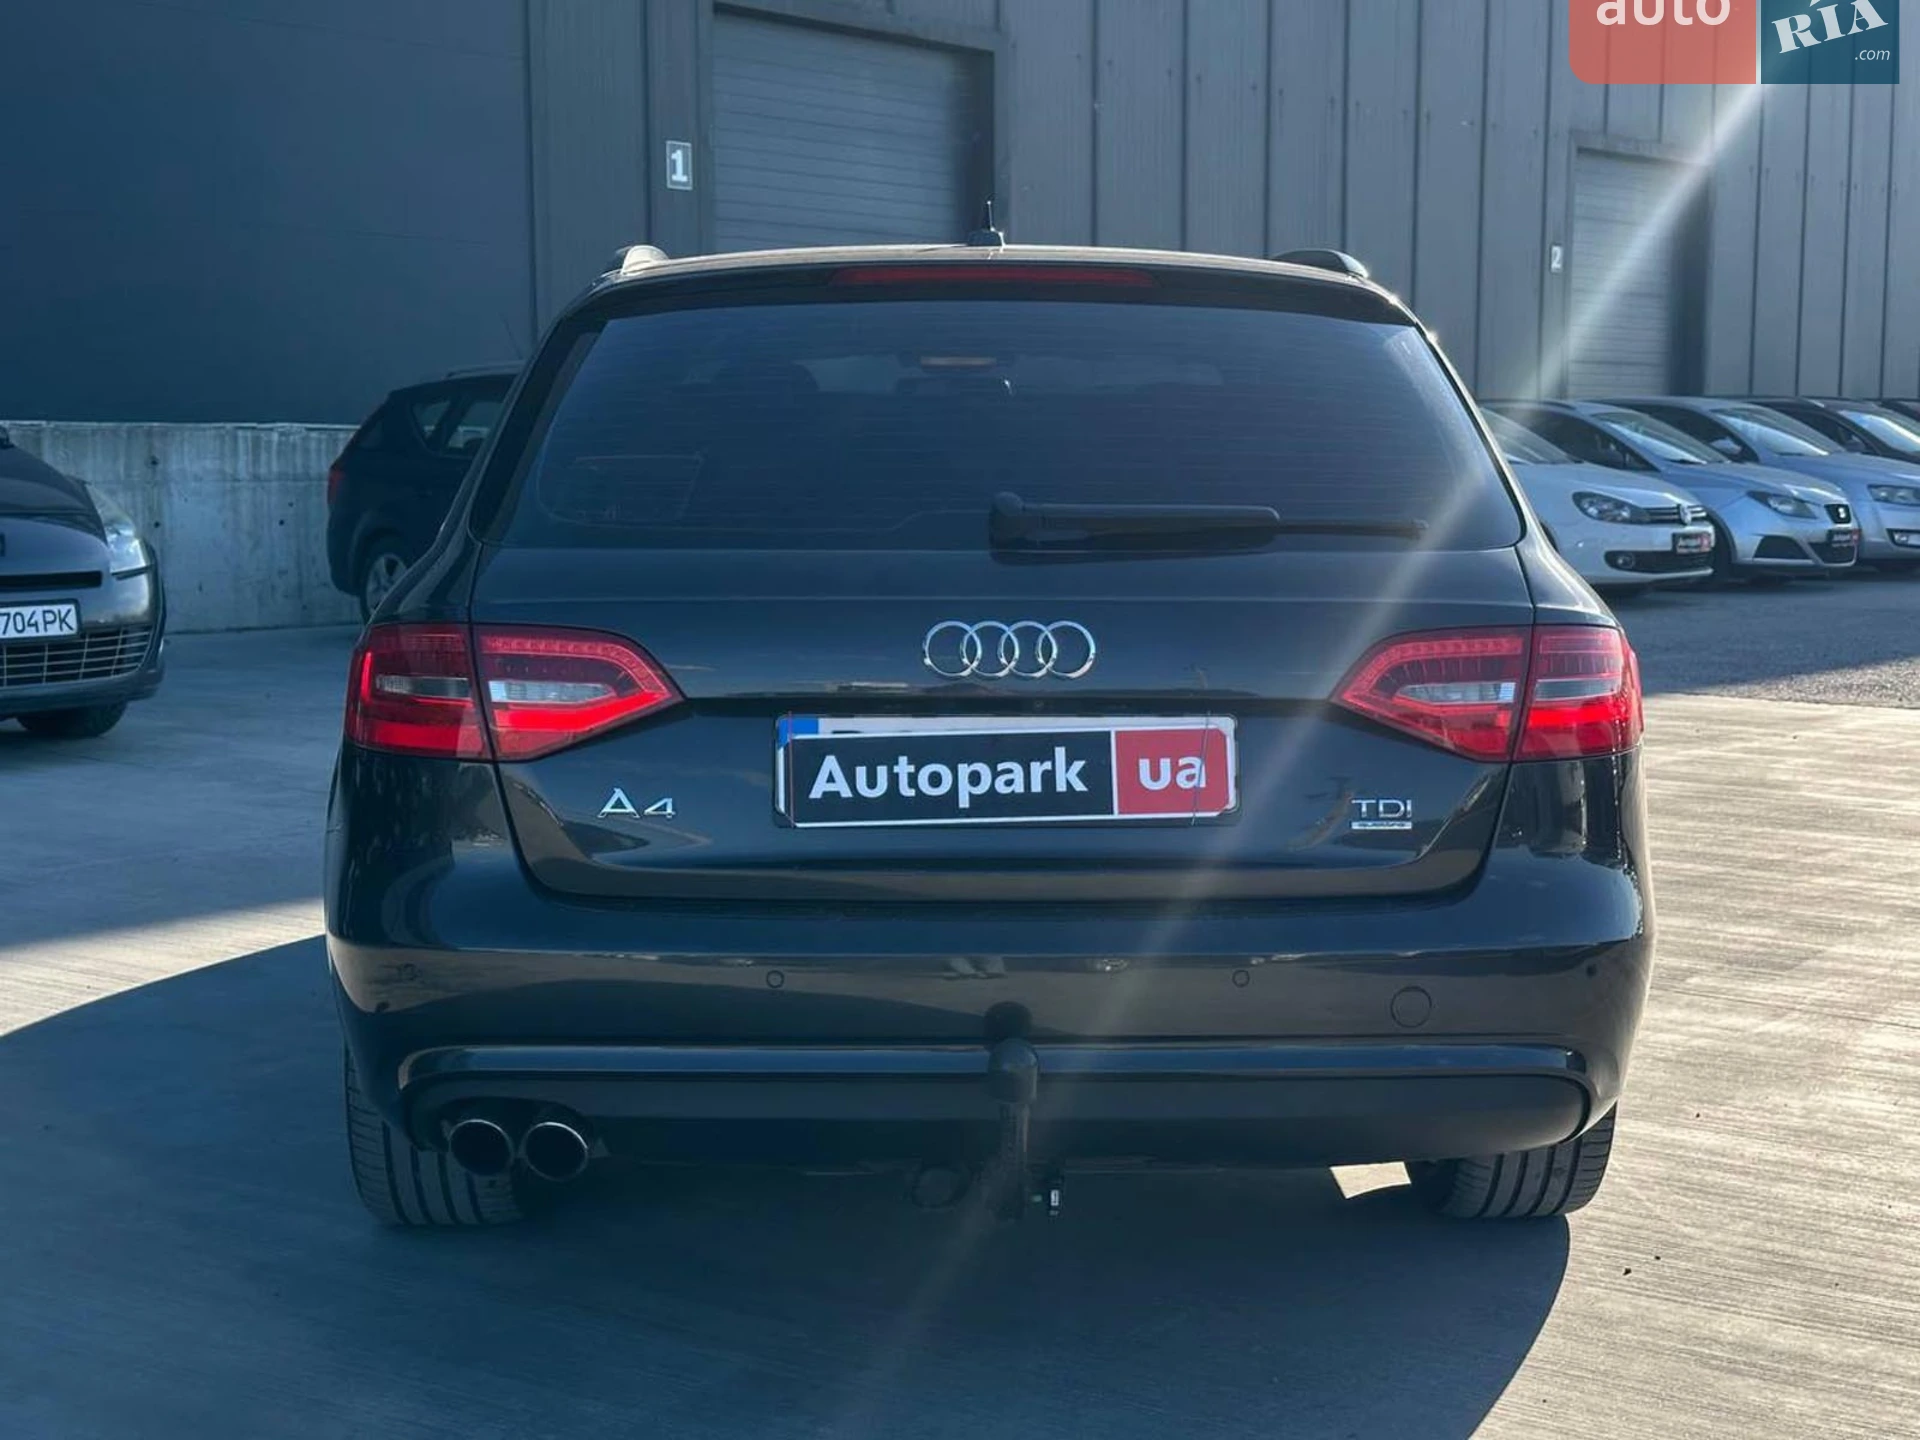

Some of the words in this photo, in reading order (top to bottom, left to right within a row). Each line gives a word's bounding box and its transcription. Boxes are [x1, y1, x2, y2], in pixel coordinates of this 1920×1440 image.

[671, 148, 688, 182] 1
[808, 746, 1088, 808] Autopark
[1138, 754, 1207, 790] ua
[597, 787, 677, 819] A4
[1351, 799, 1412, 819] TDI
